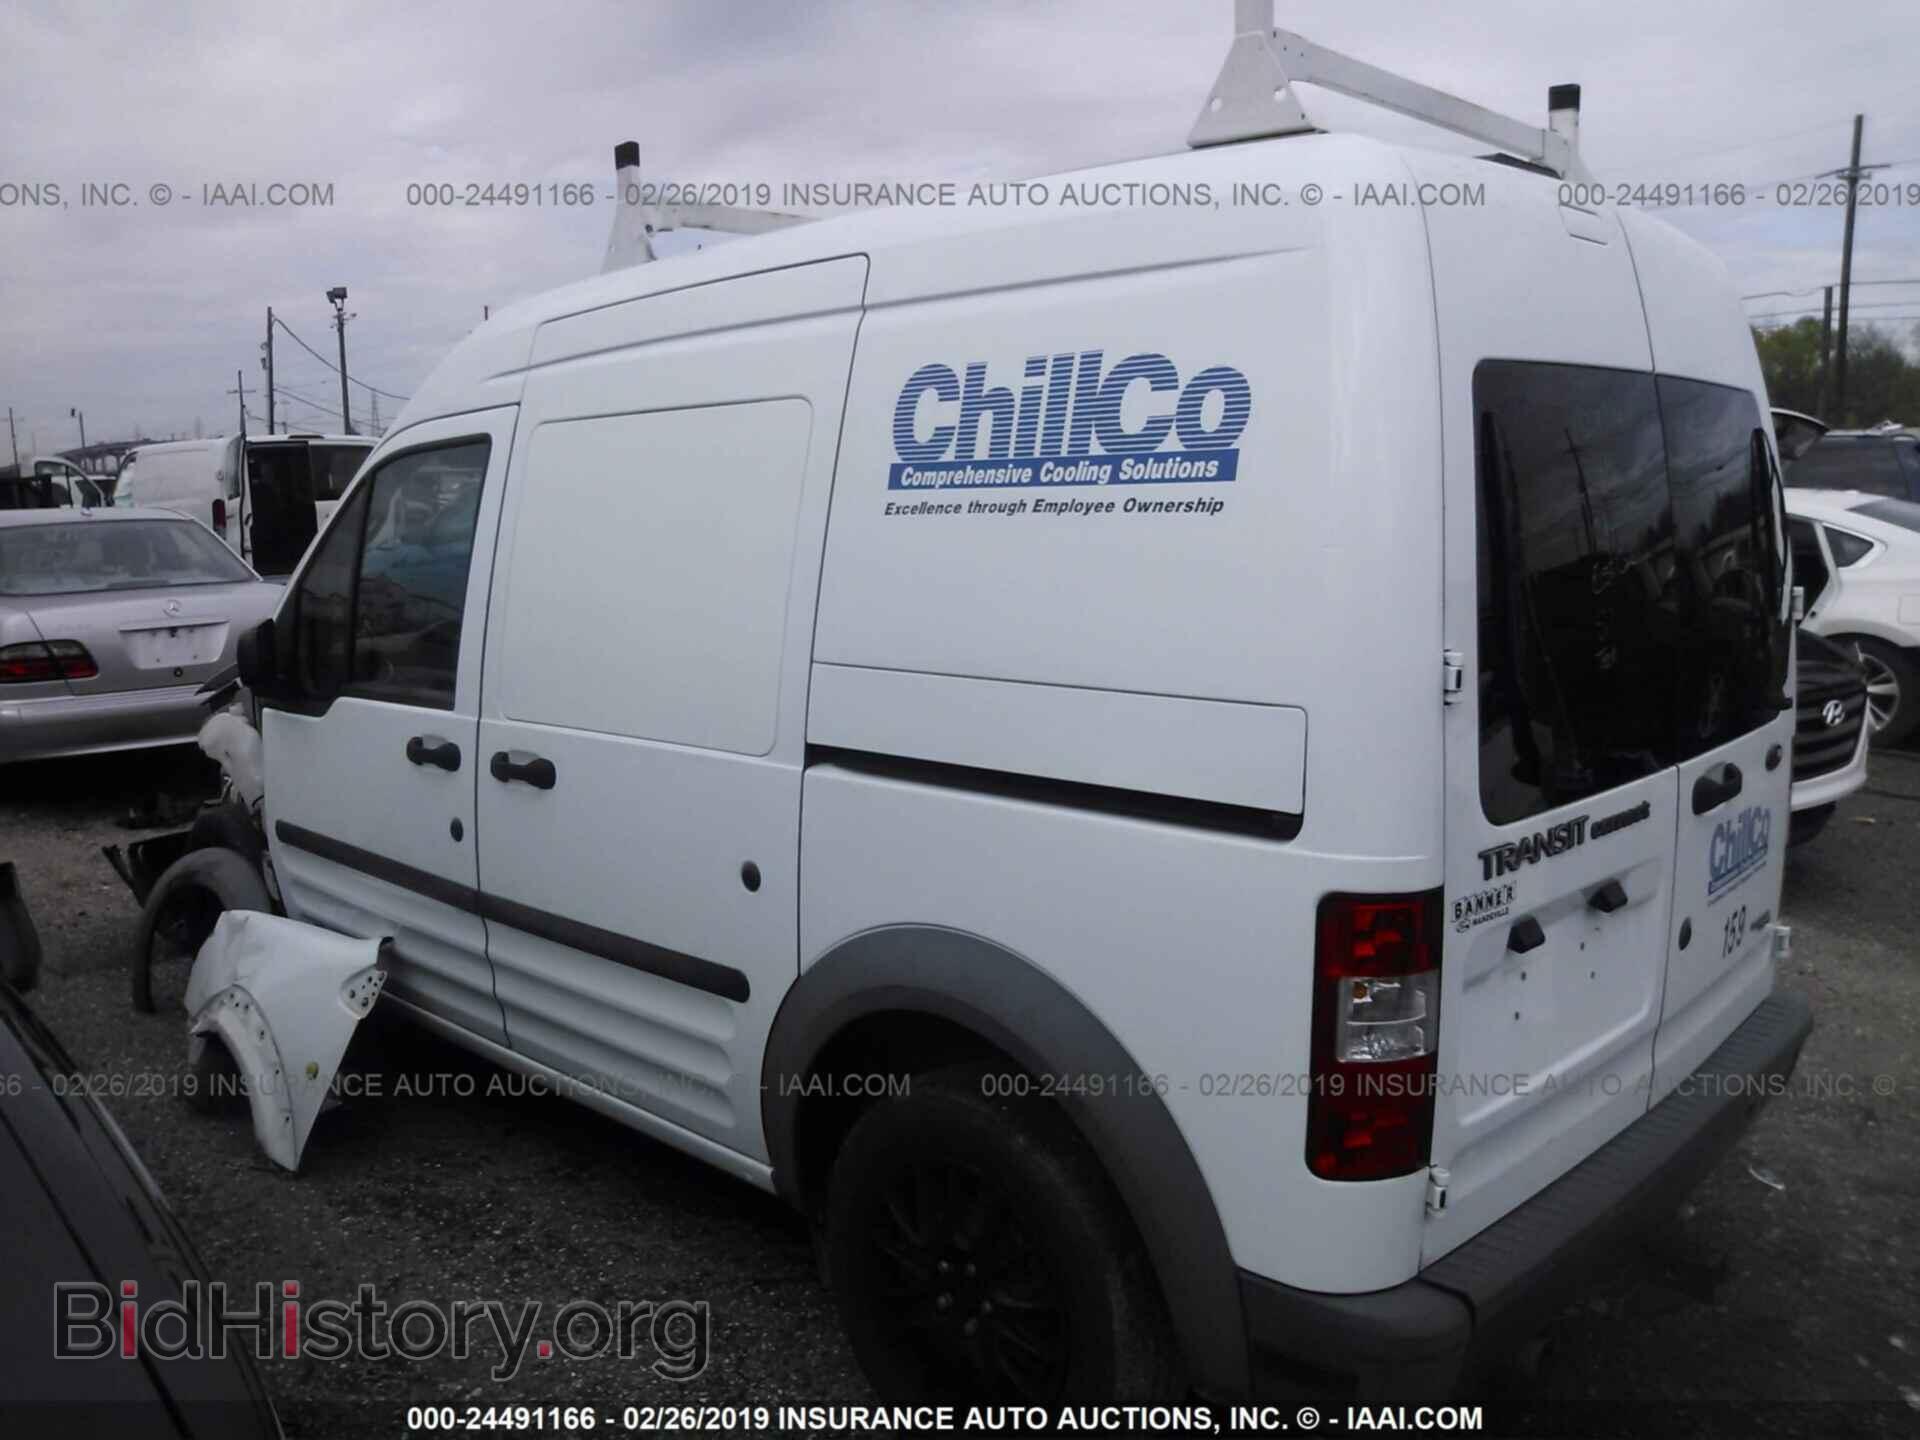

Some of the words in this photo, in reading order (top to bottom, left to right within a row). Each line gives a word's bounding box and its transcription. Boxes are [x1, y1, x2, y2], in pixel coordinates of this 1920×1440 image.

[893, 349, 1251, 462] ChillCo
[900, 464, 1032, 488] Comprehensive
[1039, 459, 1112, 485] Cooling
[1118, 456, 1219, 481] Solutions
[884, 501, 962, 516] Excellence
[967, 500, 1026, 516] through
[1031, 498, 1116, 516] Employee
[1122, 497, 1225, 516] Ownership
[1478, 815, 1589, 881] TRANSIT
[1453, 884, 1516, 921] BANNER
[1722, 905, 1746, 959] 159
